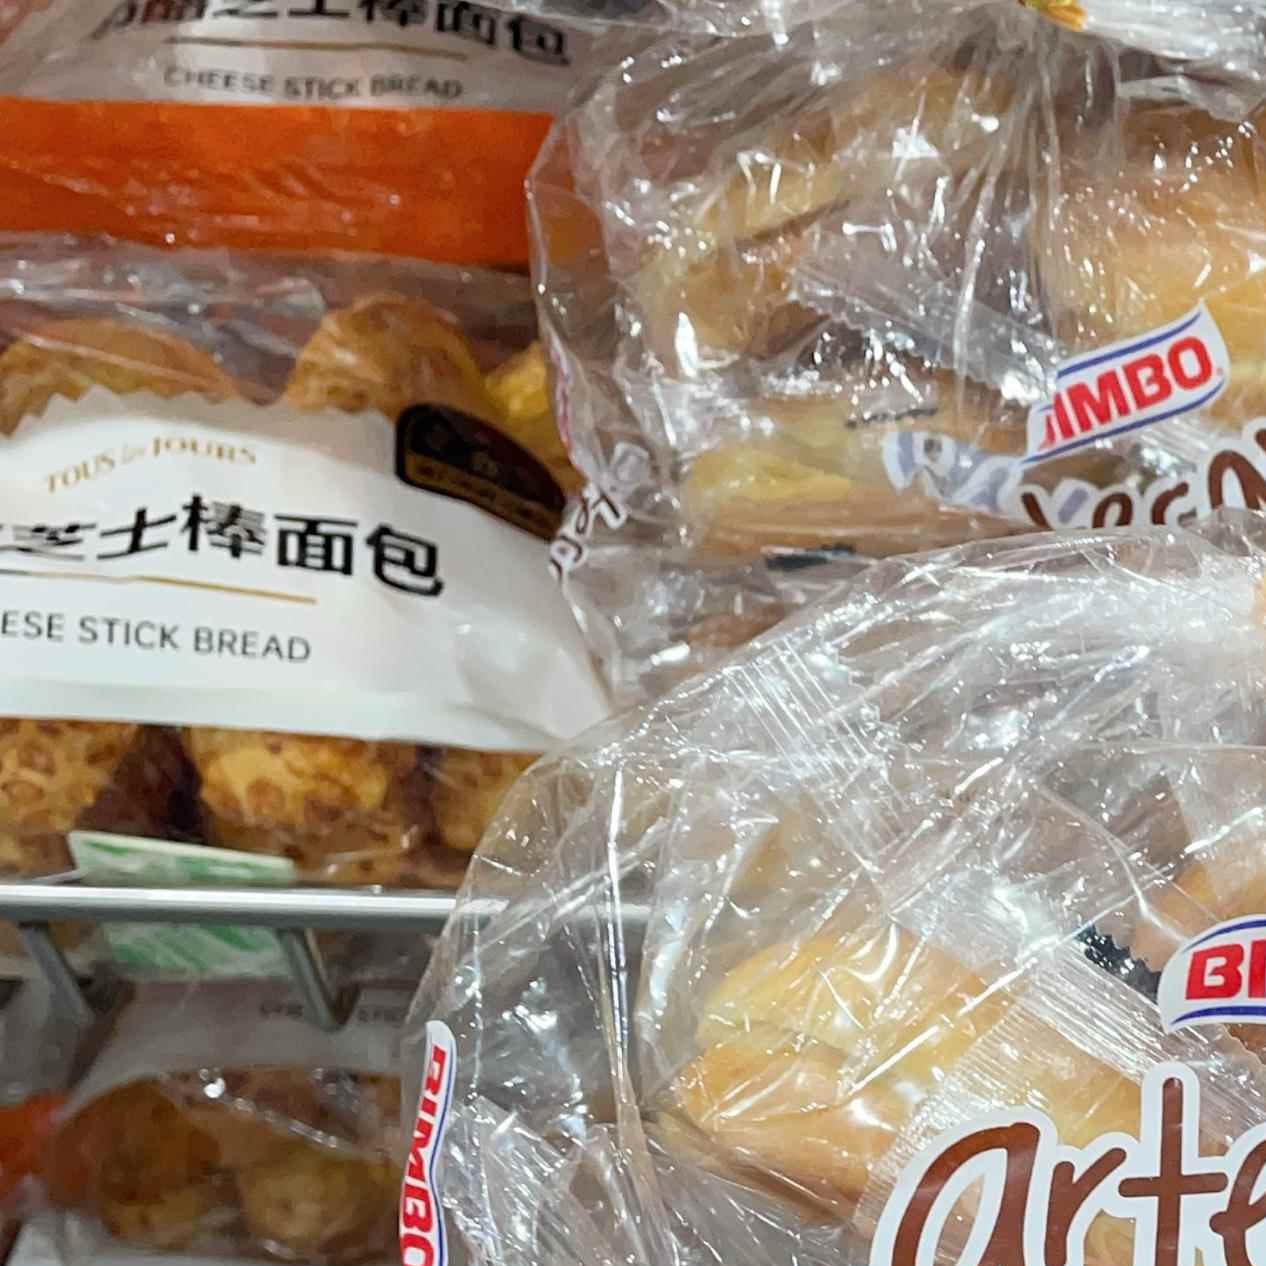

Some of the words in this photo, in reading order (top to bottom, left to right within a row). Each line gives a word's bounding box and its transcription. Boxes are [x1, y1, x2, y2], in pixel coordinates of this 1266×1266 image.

[162, 66, 273, 94] CHEESE
[283, 73, 361, 101] STICK
[370, 74, 464, 99] BREAD
[78, 614, 179, 651] STICK
[193, 618, 312, 664] BREAD
